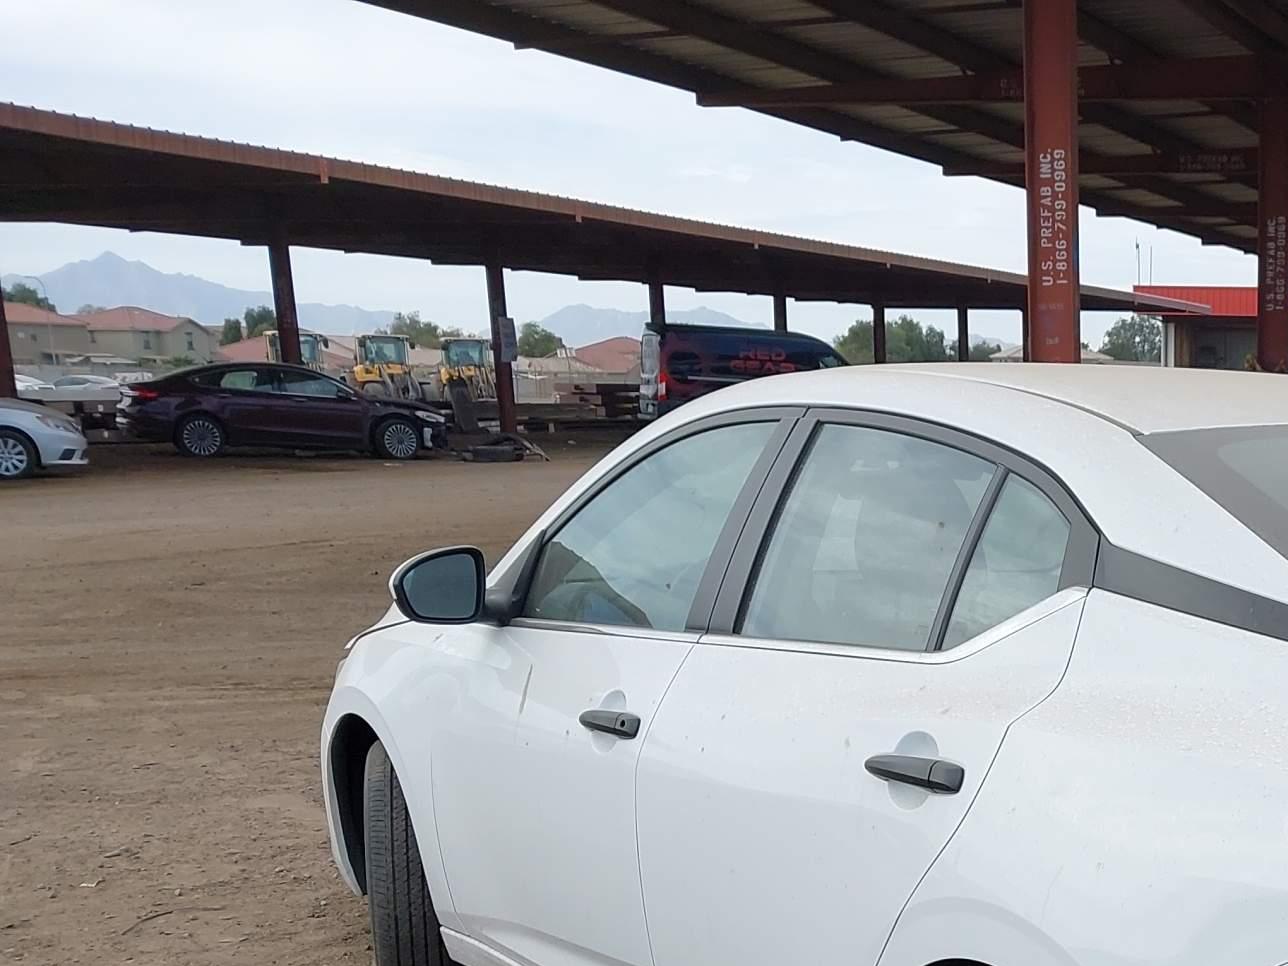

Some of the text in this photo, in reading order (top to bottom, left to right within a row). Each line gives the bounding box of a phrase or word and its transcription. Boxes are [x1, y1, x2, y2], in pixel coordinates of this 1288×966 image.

[1039, 148, 1054, 286] U.S. PREFAB INC.
[1053, 149, 1069, 284] 1-866-799-0969
